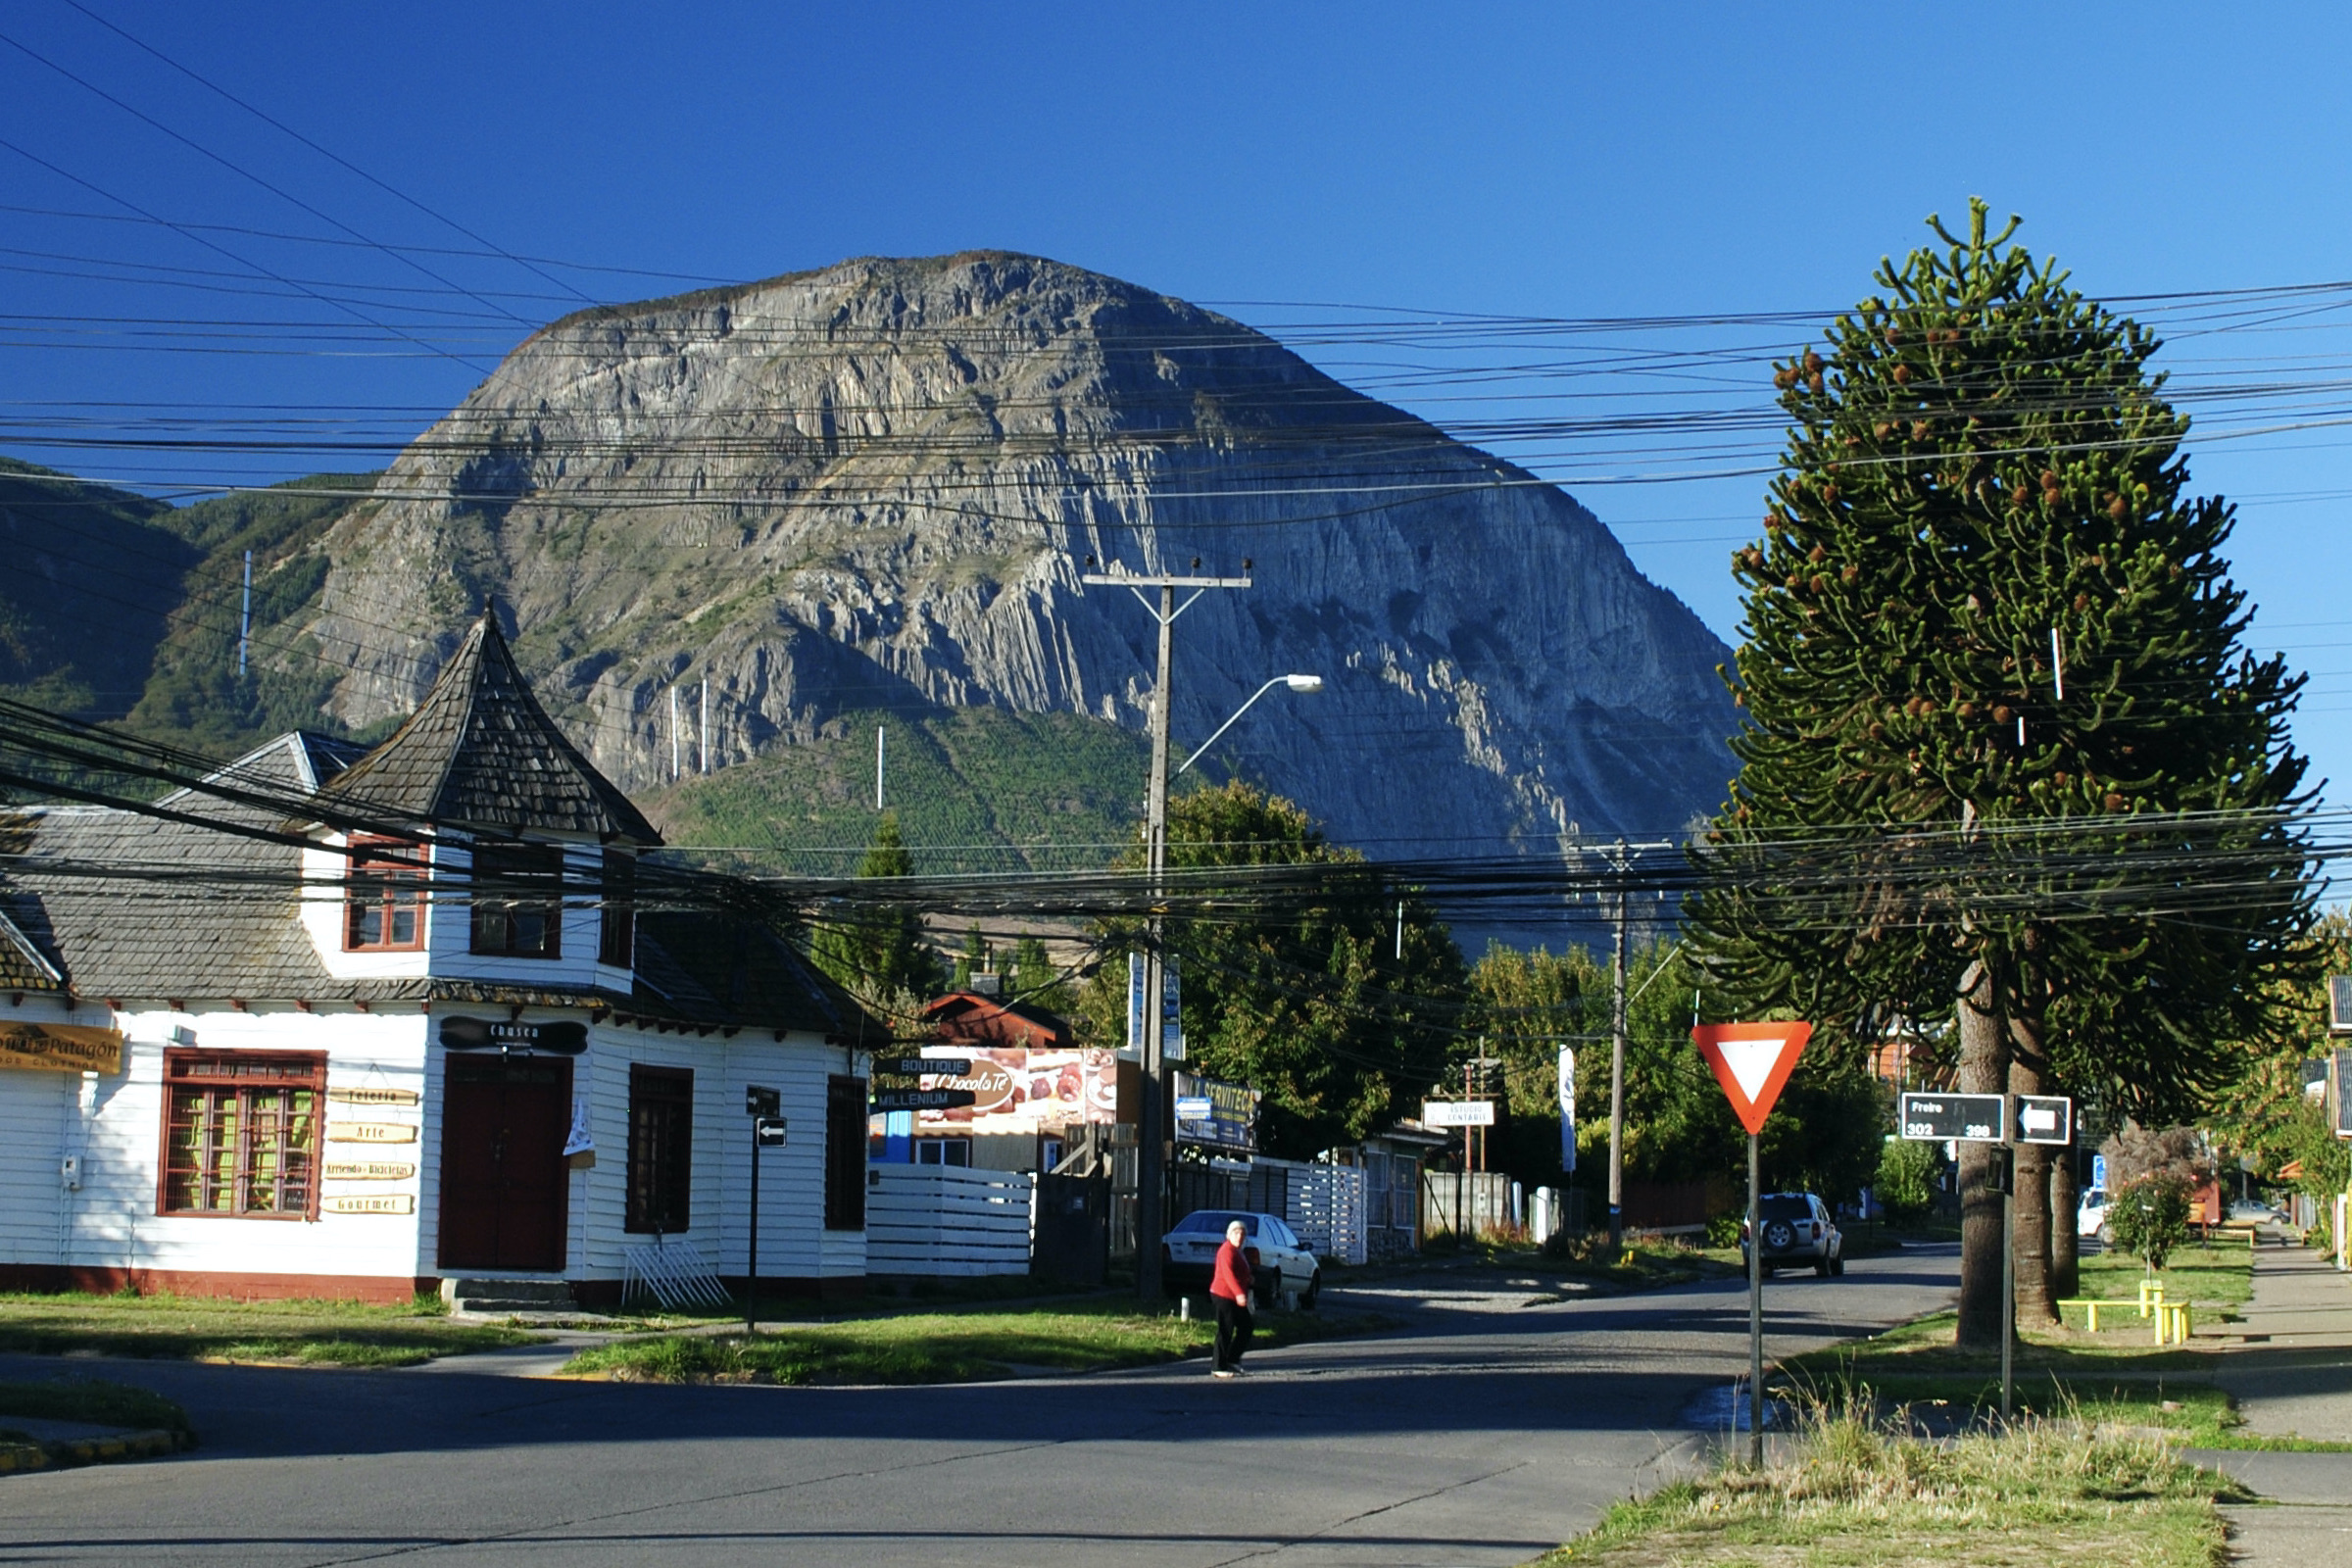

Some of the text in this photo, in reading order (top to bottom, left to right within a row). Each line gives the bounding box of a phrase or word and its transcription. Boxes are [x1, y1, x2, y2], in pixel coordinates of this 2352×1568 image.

[901, 1058, 965, 1074] BOUTIQUE
[878, 1092, 949, 1106] MILLENIUM
[357, 1126, 385, 1138] Arte
[1907, 1123, 1934, 1136] 302
[338, 1199, 396, 1211] Gourmet
